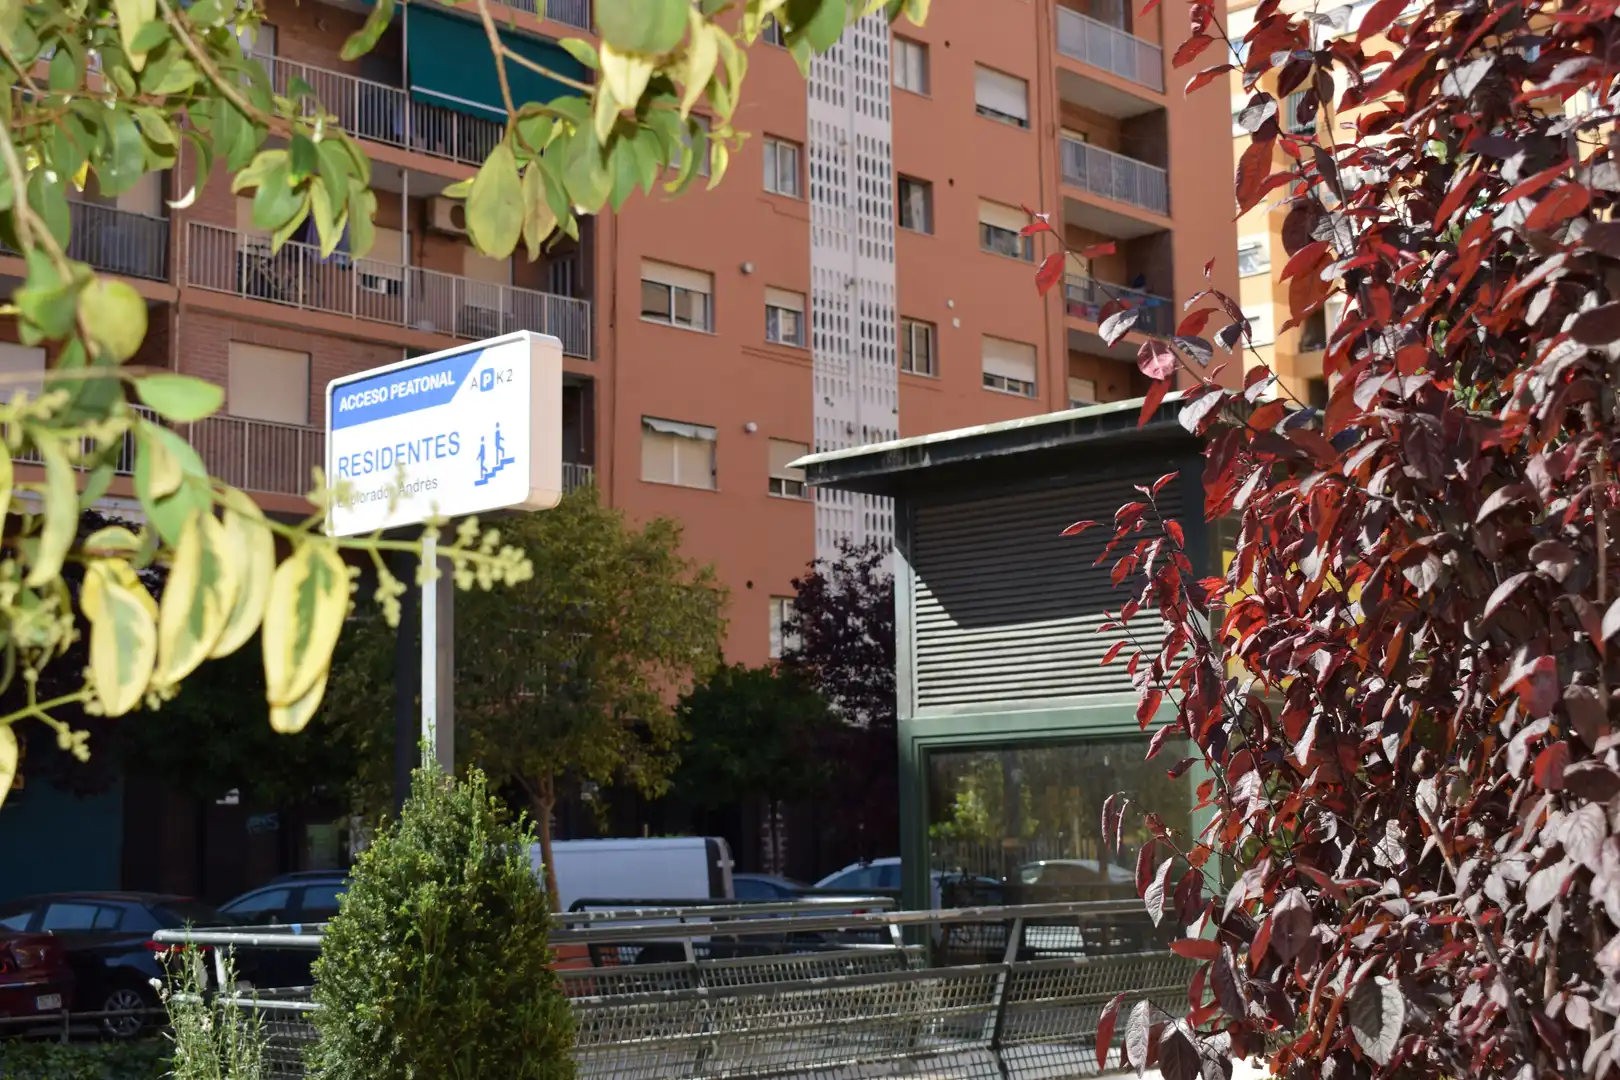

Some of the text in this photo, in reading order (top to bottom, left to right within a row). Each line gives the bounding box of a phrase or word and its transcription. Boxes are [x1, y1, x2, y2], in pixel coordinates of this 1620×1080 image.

[339, 370, 456, 413] ACCESO PEATONAL
[338, 431, 460, 479] RESIDENTES
